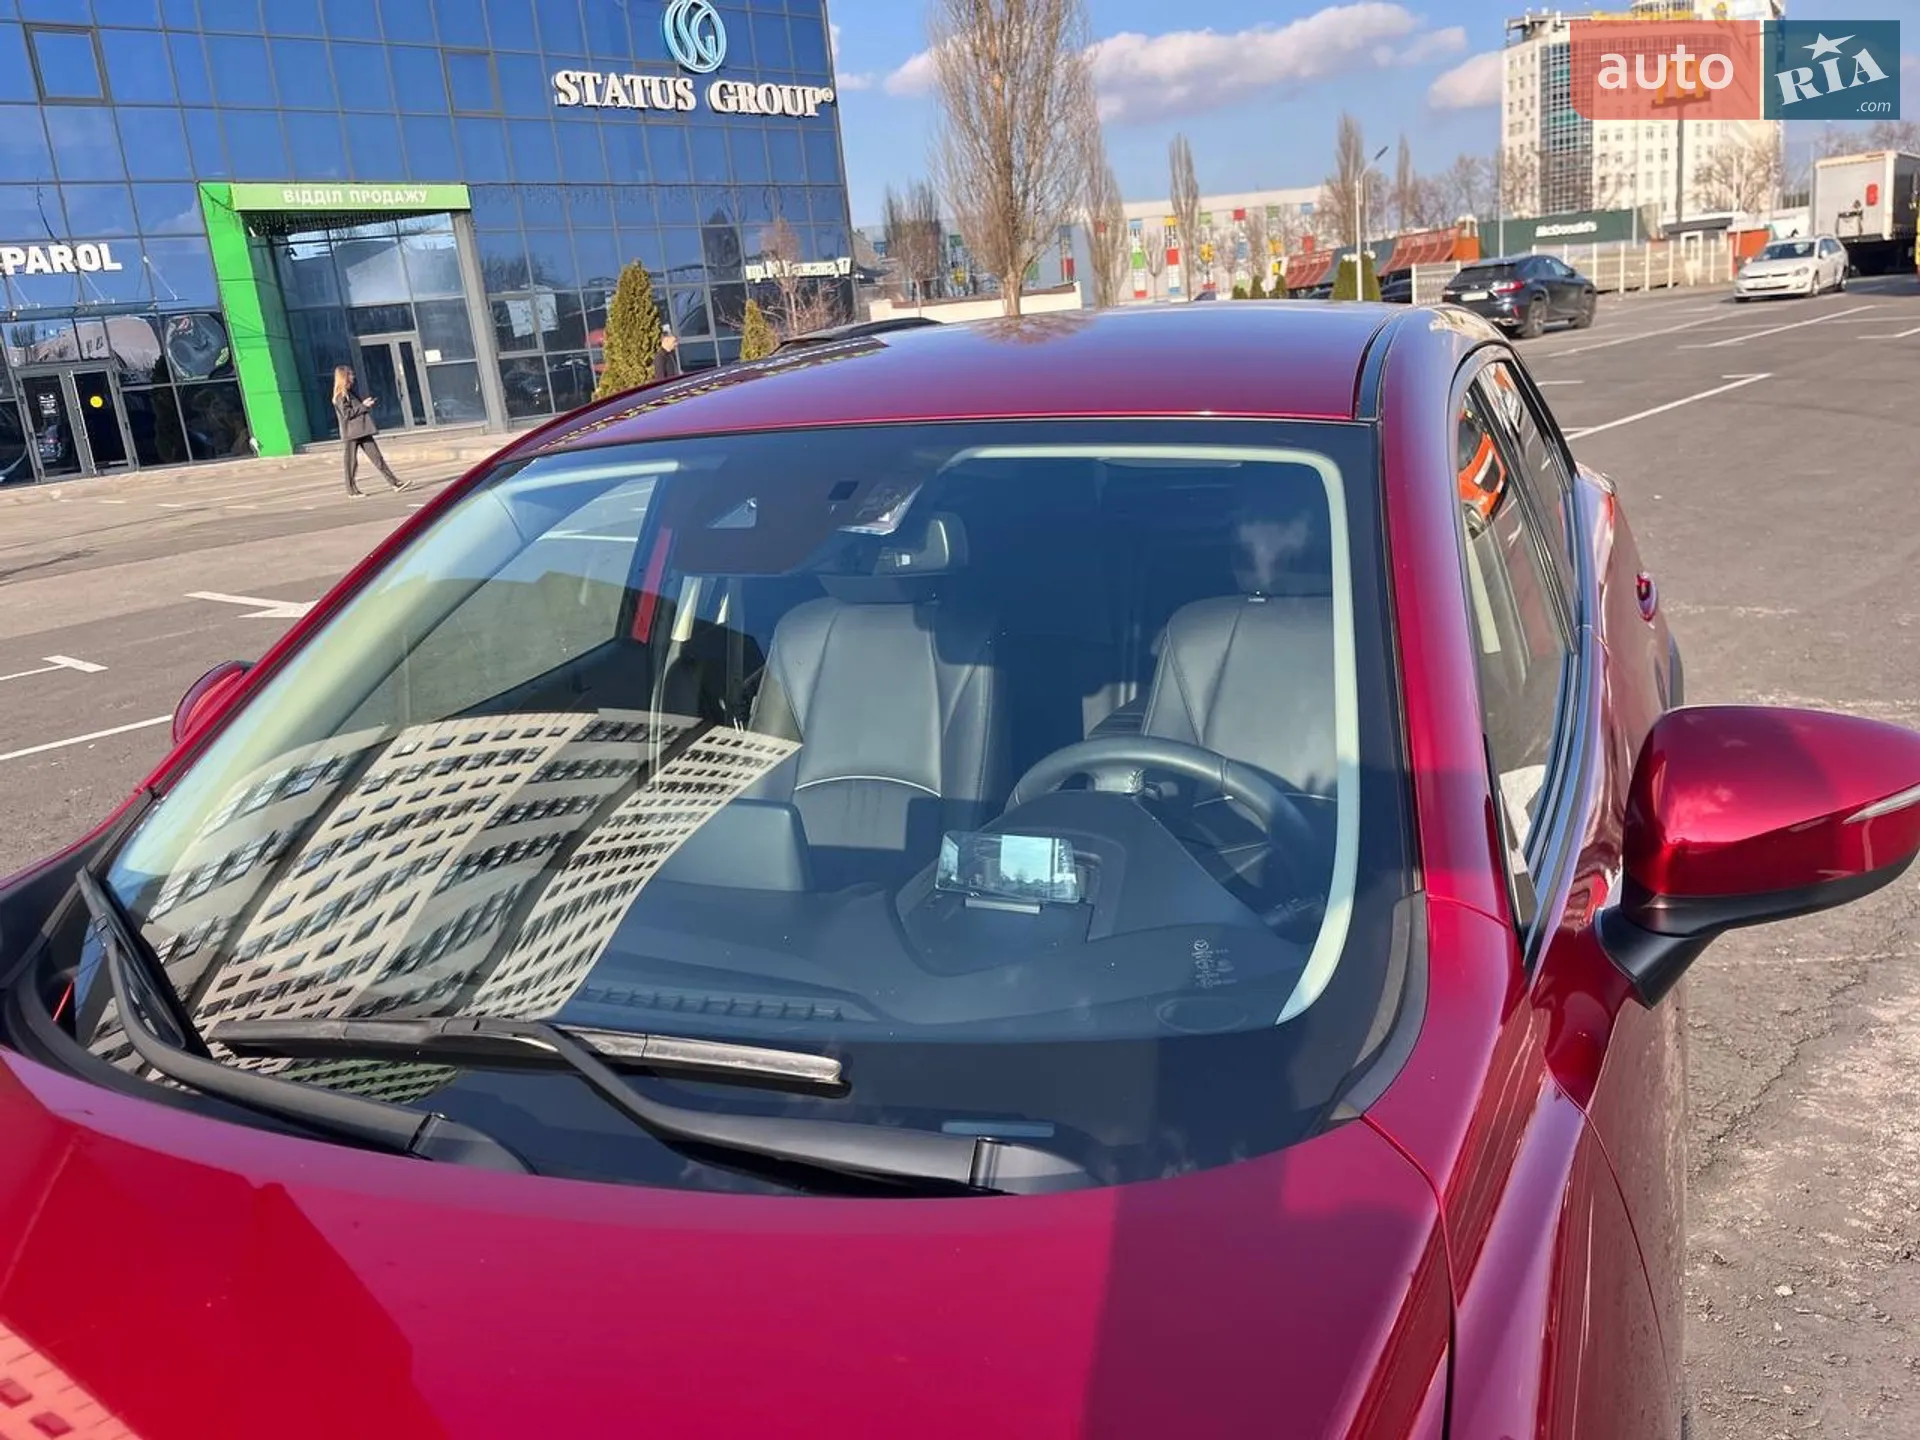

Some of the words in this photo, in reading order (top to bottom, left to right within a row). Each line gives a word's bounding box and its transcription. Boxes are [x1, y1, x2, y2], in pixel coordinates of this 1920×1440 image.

[554, 70, 696, 112] STATUS
[283, 189, 343, 205] ВІДДІЛ
[350, 189, 428, 205] ПРОДАЖУ
[0, 243, 123, 276] PAROL
